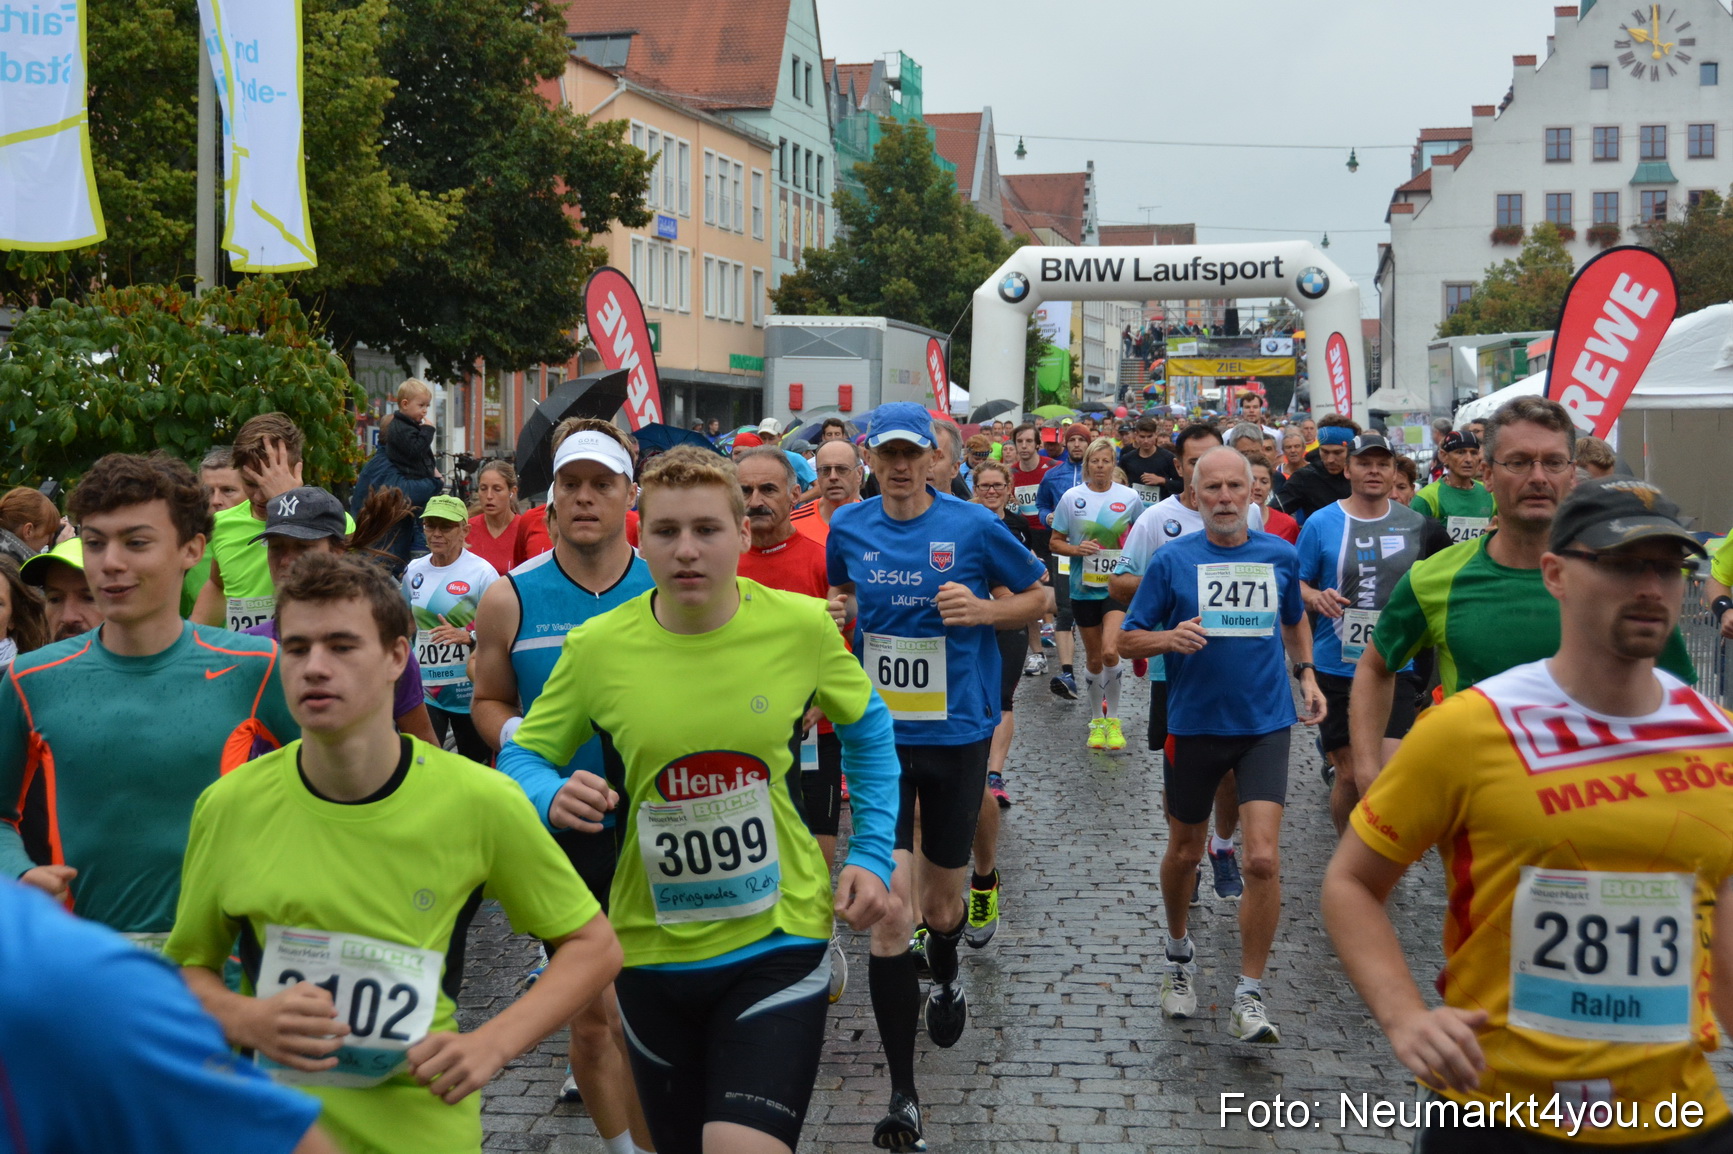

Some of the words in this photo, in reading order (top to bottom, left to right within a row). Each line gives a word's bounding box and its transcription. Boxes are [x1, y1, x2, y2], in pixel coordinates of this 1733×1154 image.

[1041, 257, 1125, 282] BMW
[1134, 255, 1284, 286] Laufsport
[1558, 272, 1659, 437] REWE
[1216, 362, 1247, 373] ZIEL
[1137, 490, 1158, 503] 556
[863, 551, 880, 562] MIT
[867, 569, 923, 586] JESUS
[1235, 565, 1268, 574] BOCK
[1355, 536, 1377, 608] MATEC
[1208, 580, 1269, 607] 2471
[1221, 614, 1259, 626] Norbert
[419, 643, 465, 665] 2024
[896, 640, 938, 650] BOCK
[428, 669, 455, 678] Theres
[878, 655, 929, 689] 600
[693, 791, 758, 818] BOCK
[1536, 772, 1648, 816] MAX
[648, 814, 688, 823] NeuerMarkt
[655, 817, 768, 877] 3099
[659, 886, 738, 907] Springendes
[1530, 886, 1589, 901] NeuerMarkt
[1601, 878, 1680, 899] BOCK
[1532, 910, 1679, 978] 2813
[1571, 990, 1642, 1023] Ralph
